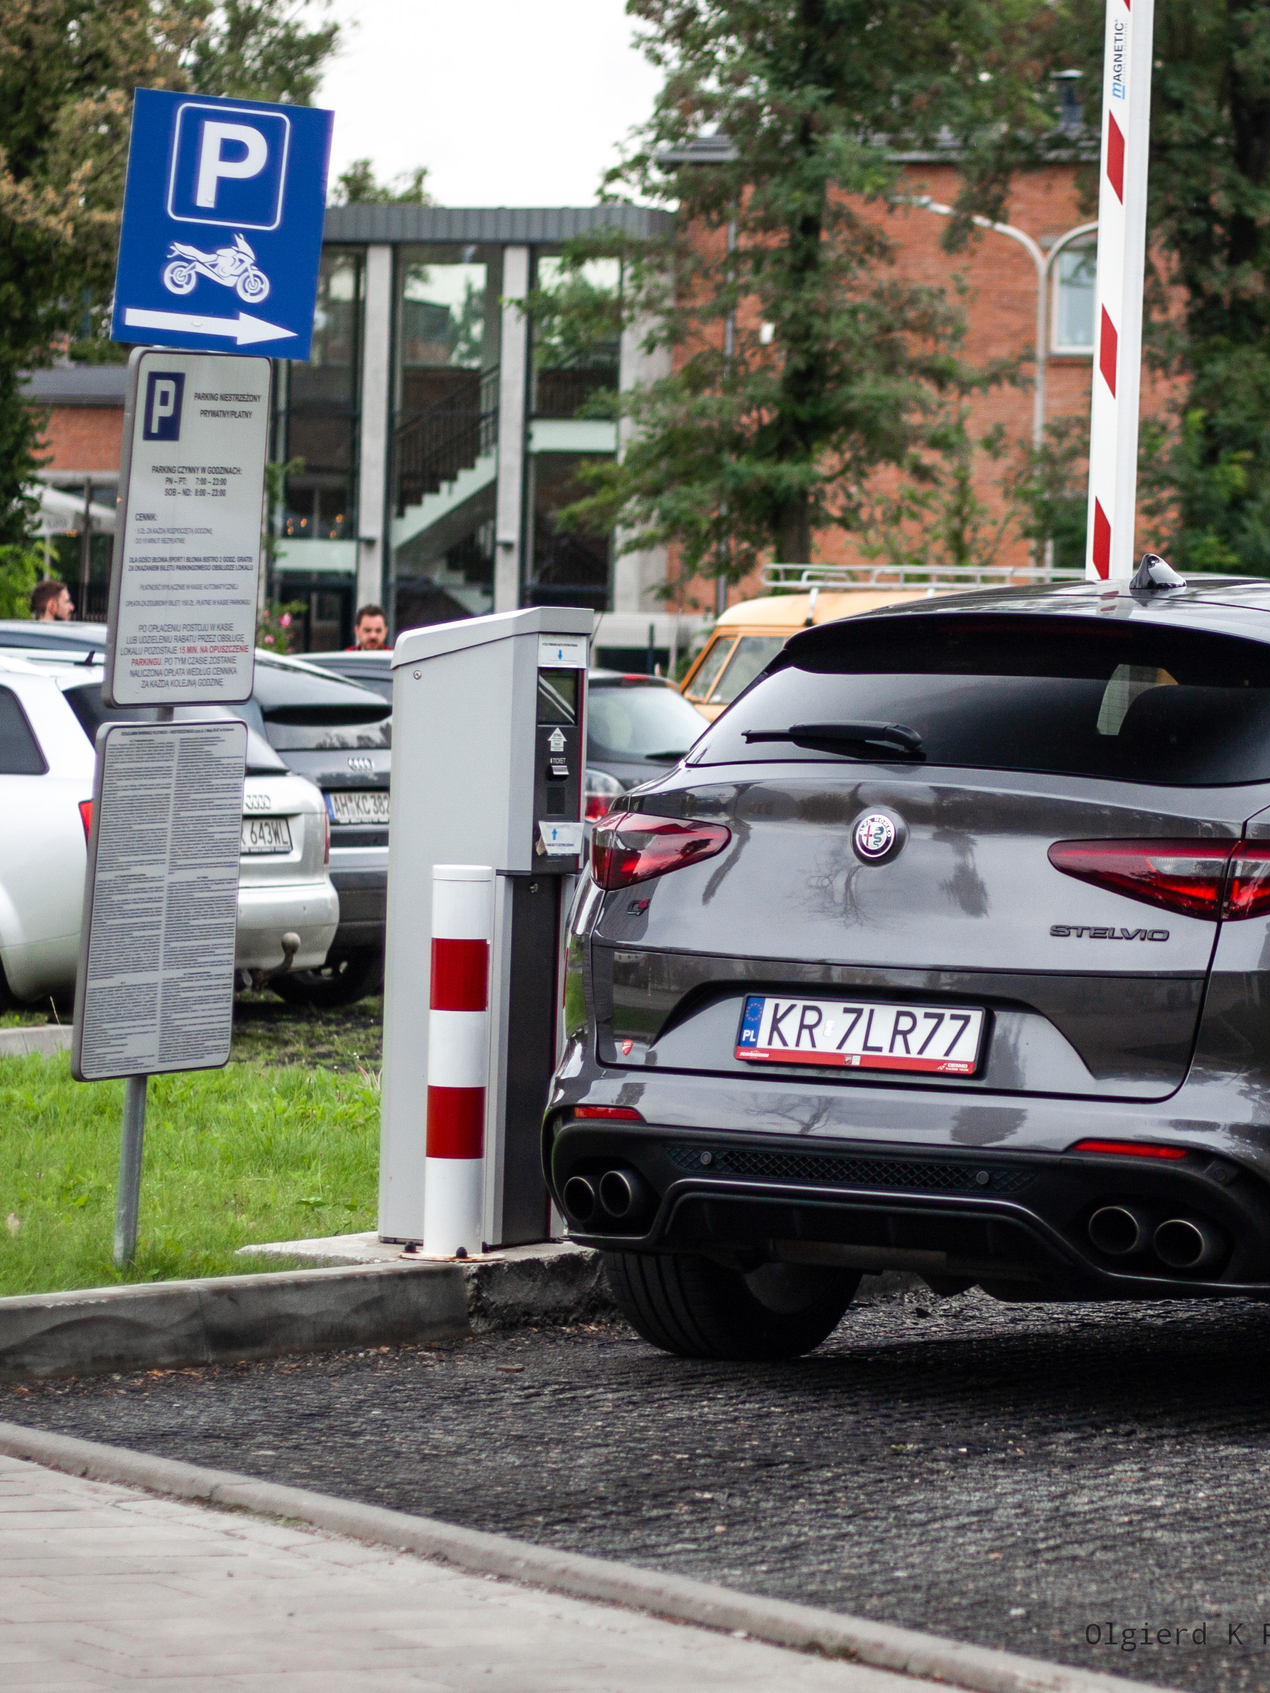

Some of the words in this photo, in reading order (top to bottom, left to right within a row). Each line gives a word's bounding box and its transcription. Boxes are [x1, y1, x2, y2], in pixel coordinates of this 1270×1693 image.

[196, 121, 268, 208] P
[194, 392, 219, 401] PARKING
[219, 392, 261, 402] NIESTRZEŻONY
[151, 379, 176, 433] P
[152, 465, 176, 474] PARKING
[177, 465, 200, 474] CZYNNY
[200, 466, 206, 474] W
[207, 466, 242, 475] GODZINACH:
[165, 477, 173, 485] PN
[195, 477, 207, 485] 7:00
[212, 478, 227, 486] 23:00
[164, 488, 176, 496] SOB
[194, 488, 206, 496] 8:00
[135, 513, 157, 521] CENNIK:
[138, 625, 147, 633] PO
[148, 624, 180, 632] OPŁACENIU
[182, 624, 209, 632] POSTOJU
[209, 624, 216, 632] W
[217, 623, 233, 631] KASIE
[126, 636, 137, 644] LUB
[138, 635, 172, 644] UDZIELENIU
[174, 635, 196, 643] RABATU
[197, 634, 216, 643] PRZEZ
[120, 647, 143, 655] LOKALU
[144, 646, 177, 655] POZOSTAJE
[179, 646, 185, 654] 15
[186, 646, 198, 654] MIN.
[200, 645, 208, 653] NA
[209, 645, 249, 653] OPUSZCZENIE
[164, 657, 173, 665] PO
[174, 657, 186, 665] TYM
[187, 656, 207, 665] CZASIE
[208, 656, 236, 664] ZOSTANIE
[129, 669, 162, 677] NALICZONA
[164, 668, 185, 677] OPŁATA
[186, 667, 211, 676] WEDŁUG
[212, 667, 237, 675] CENNIKA
[141, 680, 149, 688] ZA
[150, 679, 169, 689] KAŻDĄ
[170, 679, 197, 689] KOLEJNĄ
[334, 796, 348, 813] AH
[355, 796, 370, 815] KC
[250, 820, 288, 845] 643WL
[1050, 924, 1170, 942] STELVIO
[767, 1003, 823, 1048] KR
[836, 1006, 971, 1057] 7LR77
[742, 1029, 756, 1042] PL
